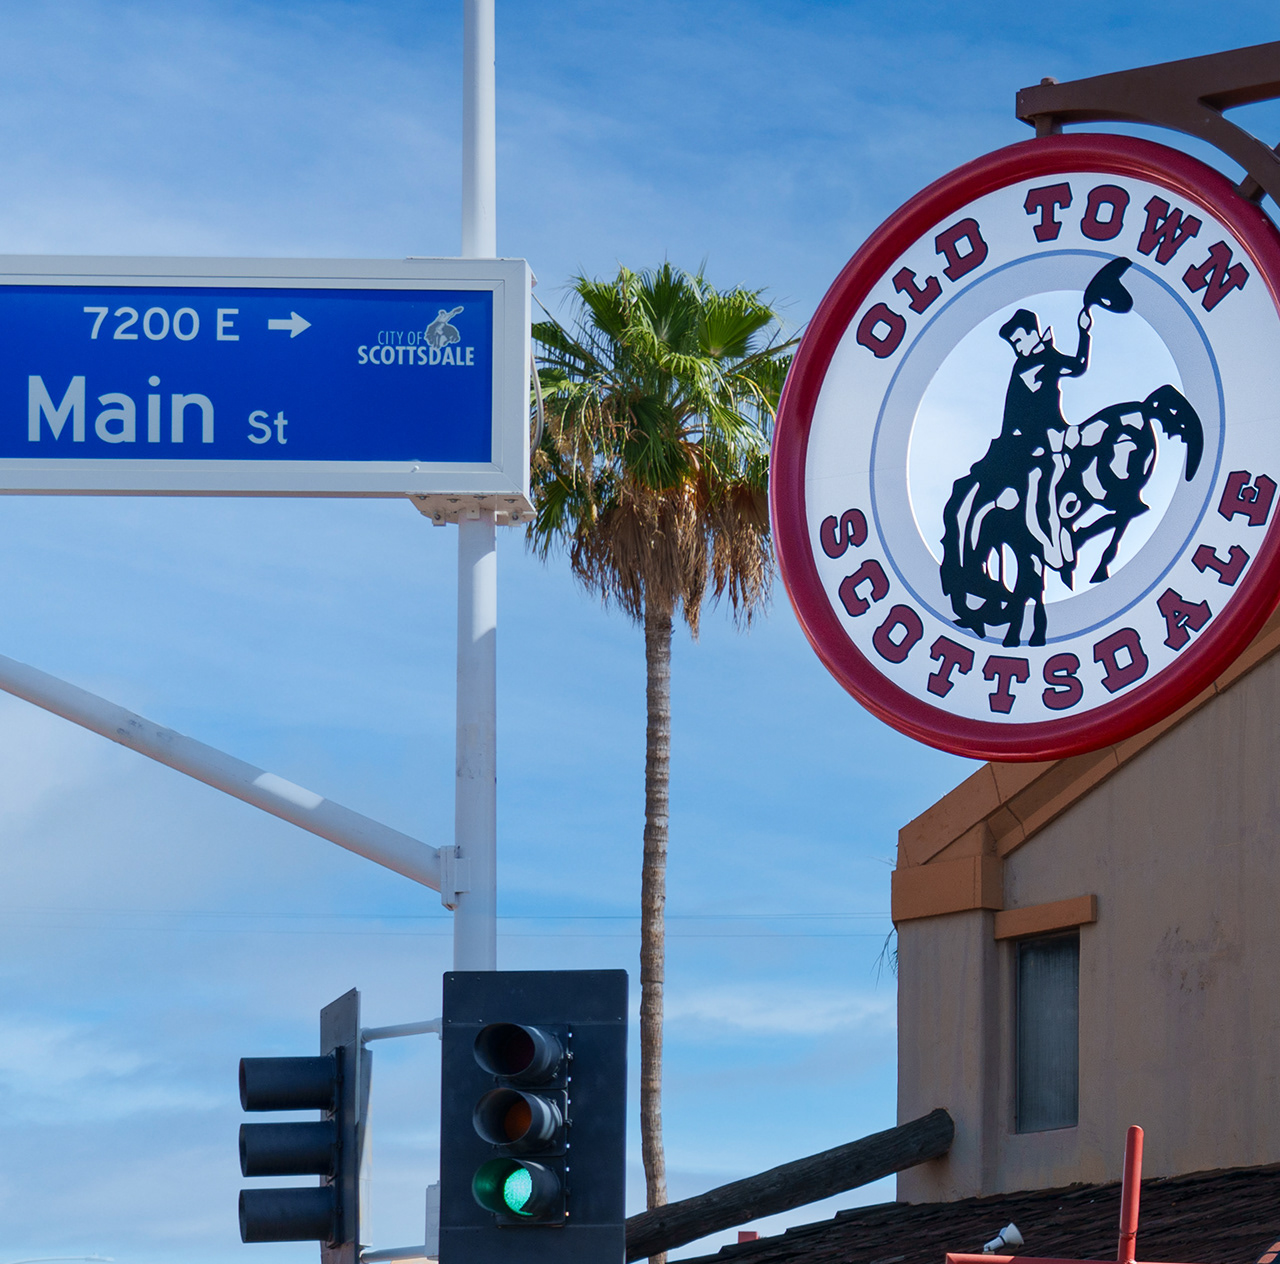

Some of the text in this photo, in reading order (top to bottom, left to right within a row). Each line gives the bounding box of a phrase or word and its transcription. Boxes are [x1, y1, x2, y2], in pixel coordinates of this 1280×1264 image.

[856, 182, 1250, 359] OLD TOWN
[83, 306, 240, 341] 7200 E
[378, 330, 423, 346] CITY OF
[358, 345, 475, 366] SCOTTSDALE
[28, 375, 289, 444] Main St
[820, 469, 1277, 714] SCOTTSDALE
